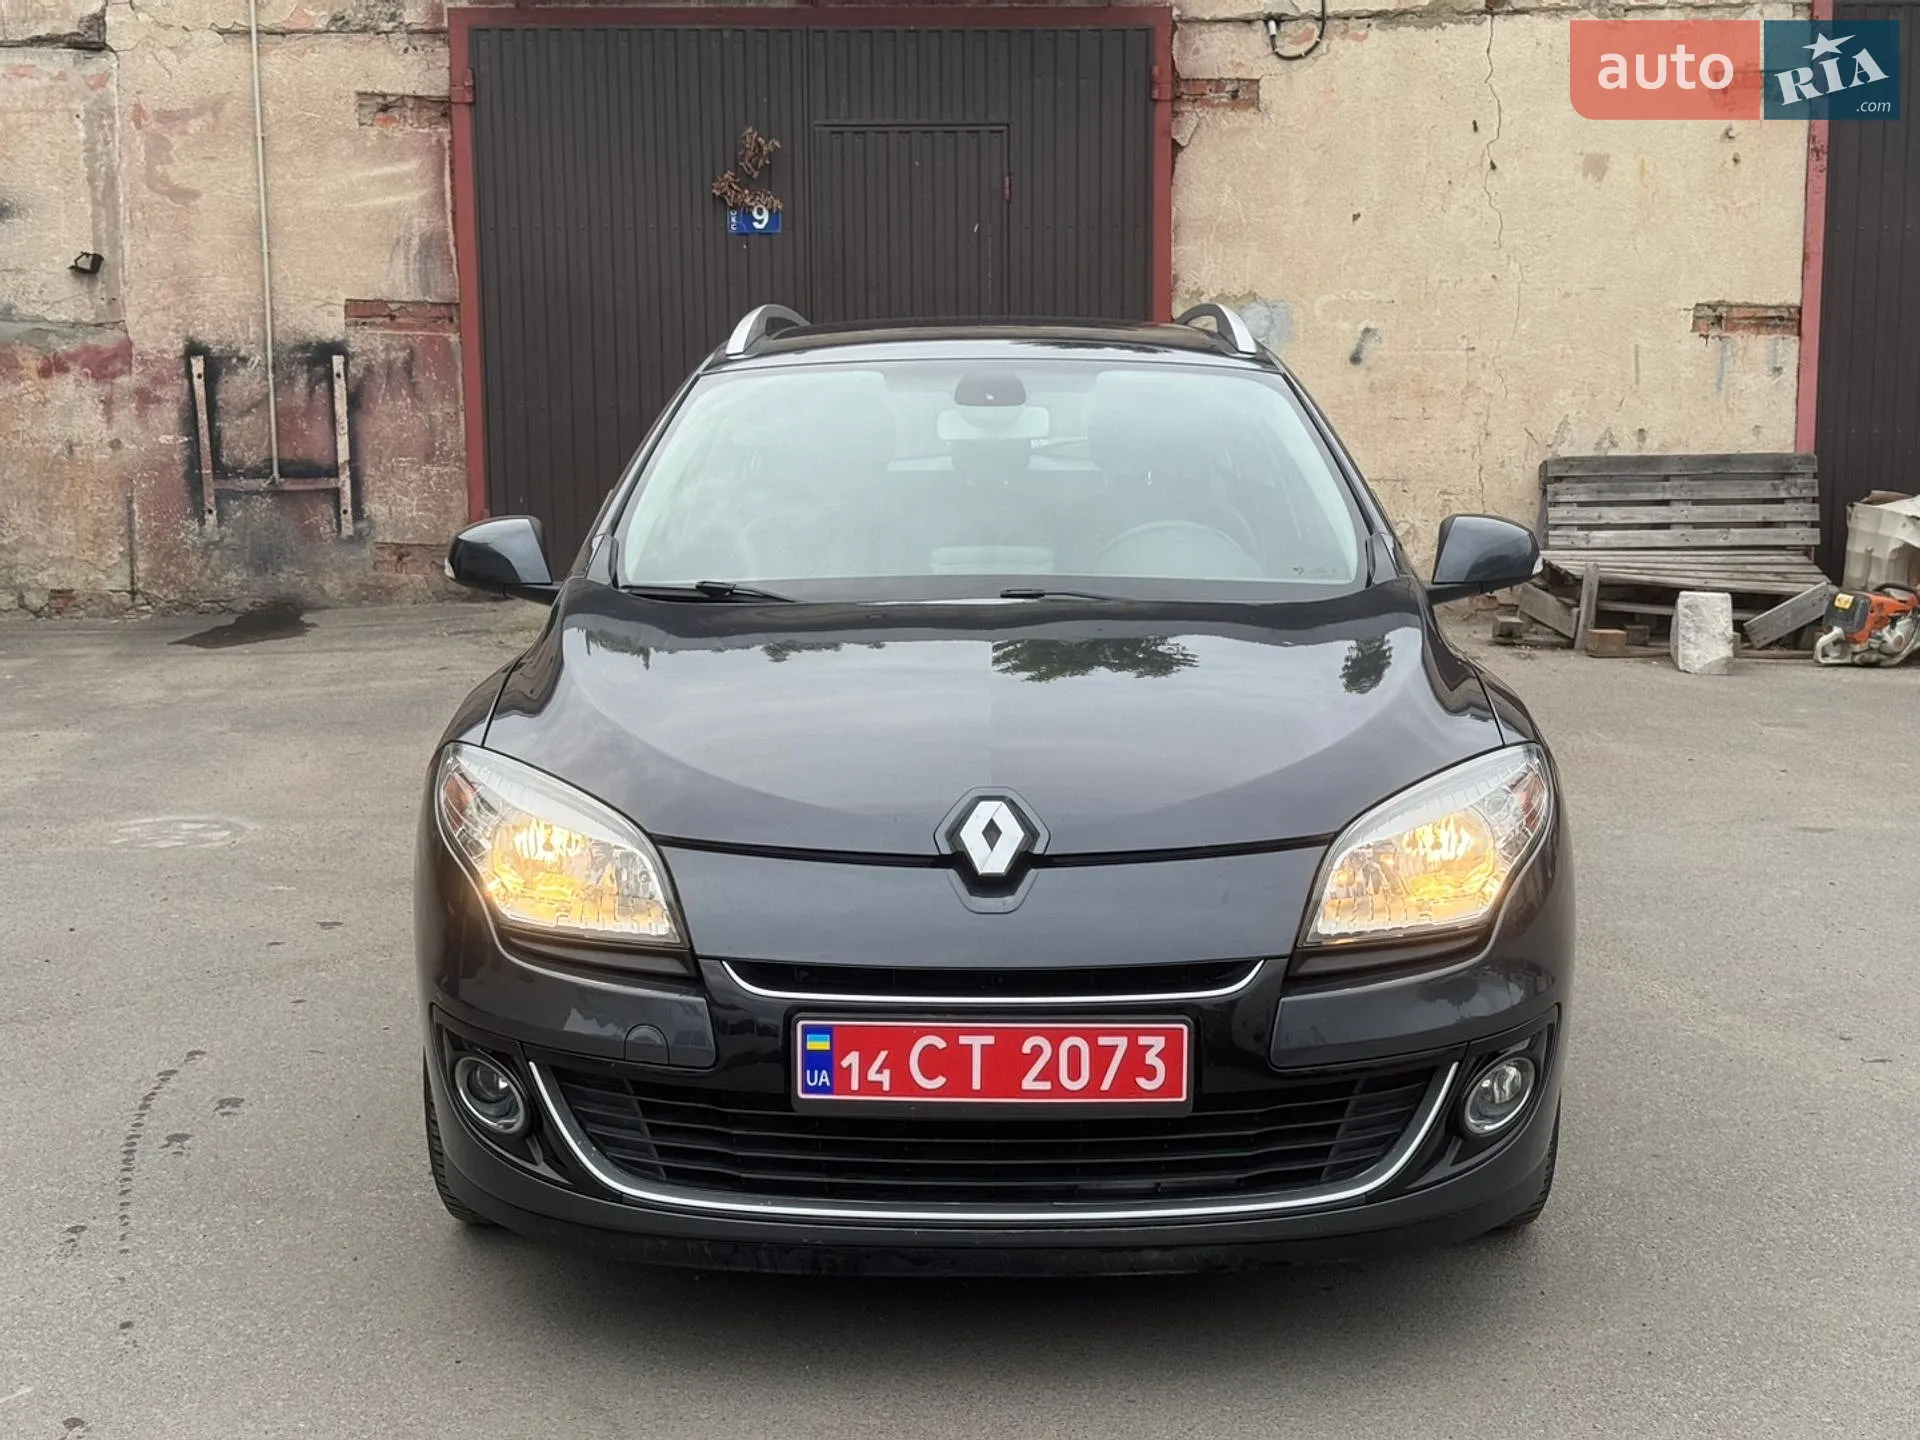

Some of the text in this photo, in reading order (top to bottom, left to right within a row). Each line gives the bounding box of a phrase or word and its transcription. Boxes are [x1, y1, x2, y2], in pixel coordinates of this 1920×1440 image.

[751, 204, 770, 230] 9
[840, 1034, 1166, 1092] 14 CT 2073
[806, 1069, 831, 1087] UA
